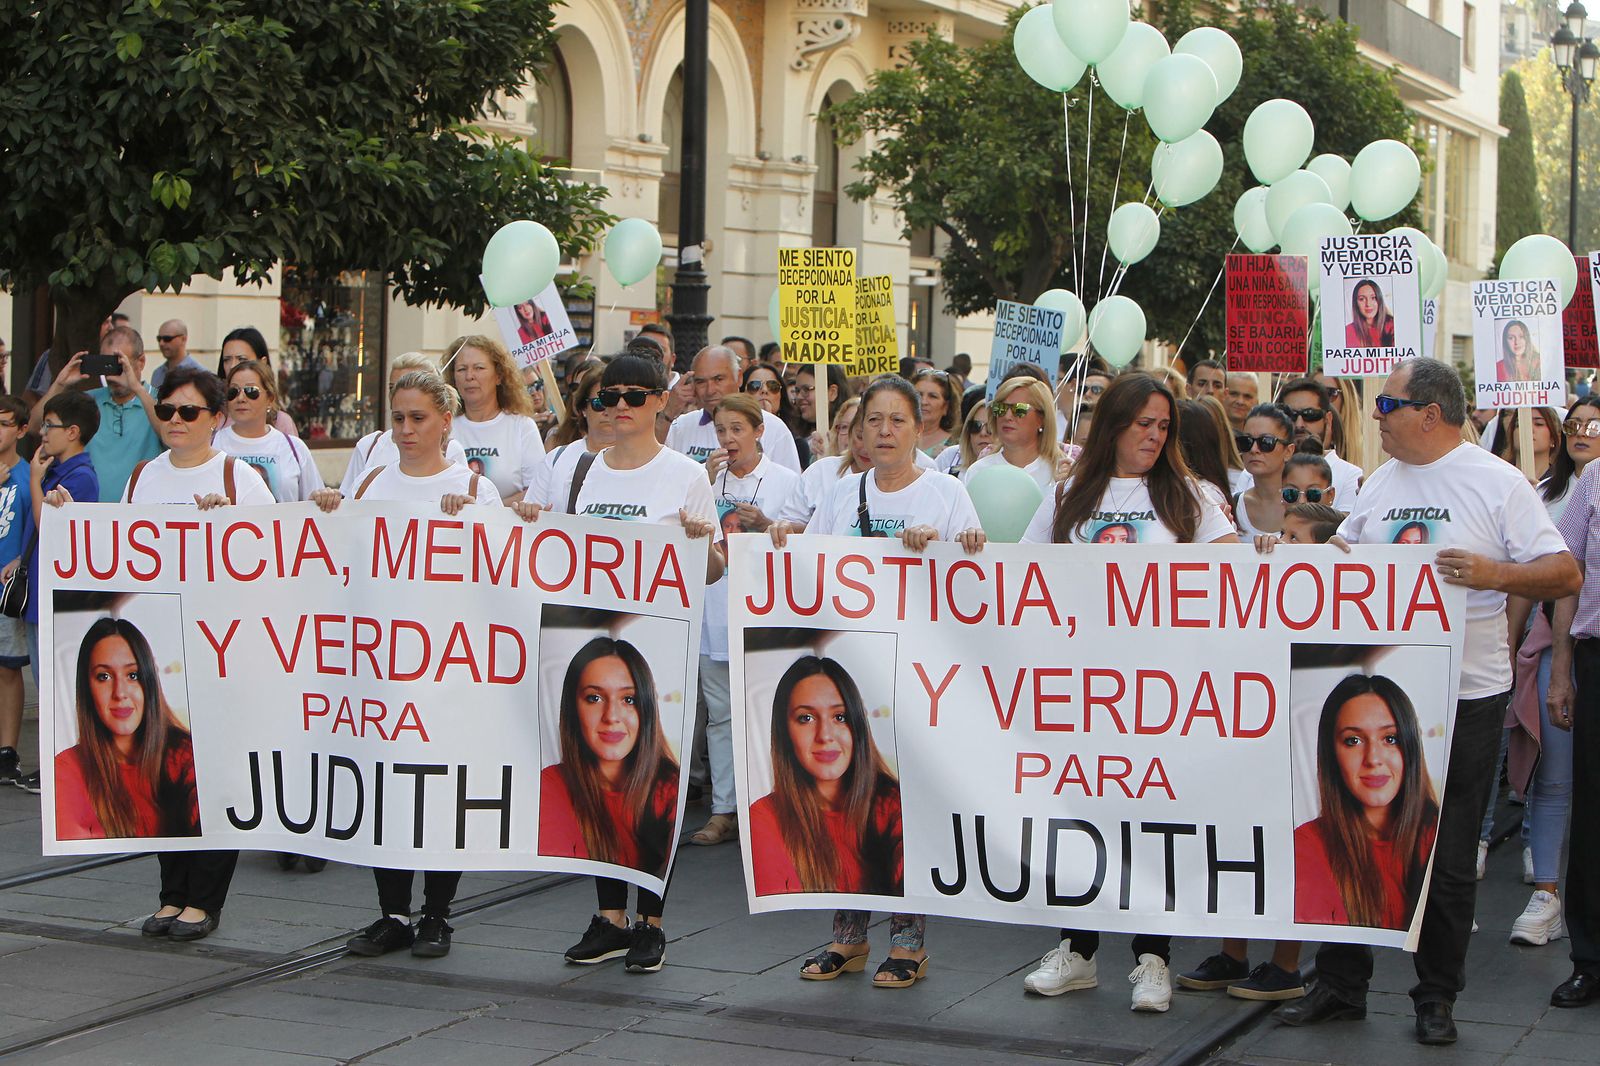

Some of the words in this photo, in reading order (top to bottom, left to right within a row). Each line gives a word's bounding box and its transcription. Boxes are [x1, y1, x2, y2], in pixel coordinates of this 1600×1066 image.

[1321, 235, 1412, 250] JUSTICIA
[779, 250, 799, 267] ME
[803, 250, 853, 267] SIENTO
[1322, 249, 1412, 263] MEMORIA
[1229, 256, 1243, 272] MI
[1247, 256, 1275, 272] HIJA
[1279, 256, 1306, 272] ERA
[1323, 263, 1334, 276] Y
[1339, 261, 1413, 276] VERDAD
[780, 269, 852, 286] DECEPCIONADA
[1229, 276, 1250, 291] UNA
[1252, 273, 1276, 291] NIÑA
[1278, 276, 1305, 291] SANA
[1474, 281, 1556, 295] JUSTICIA
[796, 290, 818, 304] POR
[822, 290, 836, 304] LA
[856, 292, 892, 310] PCIONADA
[1229, 294, 1235, 309] Y
[1236, 294, 1251, 309] MUY
[1254, 294, 1306, 310] RESPONSABLE
[1474, 292, 1557, 306] MEMORIA
[781, 307, 853, 329] JUSTICIA:
[856, 312, 867, 326] OR
[869, 311, 880, 324] LA
[997, 302, 1016, 321] ME
[1018, 306, 1063, 330] SIENTO
[1237, 311, 1297, 324] NUNCA
[1476, 306, 1486, 318] Y
[1490, 304, 1557, 317] VERDAD
[791, 330, 839, 341] COMO
[856, 325, 895, 346] STICIA:
[995, 321, 1059, 348] DECEPCIONADA
[1230, 326, 1245, 339] SE
[1250, 326, 1304, 339] BAJARIA
[512, 343, 535, 358] PARA
[536, 337, 547, 346] MI
[548, 328, 570, 342] HIJA
[858, 345, 886, 356] OMO
[1229, 341, 1245, 354] DE
[1247, 341, 1262, 354] UN
[1266, 342, 1305, 354] COCHE
[1580, 339, 1595, 351] UN
[525, 339, 566, 364] JUDITH
[783, 342, 853, 362] MADRE
[1006, 344, 1026, 360] POR
[1029, 348, 1041, 364] LA
[1326, 348, 1362, 358] PARA
[1366, 348, 1380, 358] MI
[1385, 347, 1415, 357] HIJA
[1230, 356, 1243, 369] EN
[1244, 356, 1305, 370] MARCHA
[1478, 383, 1511, 392] PARA
[1515, 382, 1528, 391] MI
[1532, 381, 1560, 390] HIJA
[1492, 391, 1548, 406] JUDITH
[464, 447, 499, 457] STICIA
[686, 445, 715, 457] JUST
[237, 455, 276, 464] STICIA
[580, 503, 648, 518] JUSTICIA
[1381, 507, 1451, 522] JUSTICIA
[850, 519, 905, 529] JSTICIA
[54, 519, 351, 587] JUSTICIA,
[372, 517, 689, 608] MEMORIA
[745, 551, 1077, 639] JUSTICIA,
[1106, 562, 1450, 633] MEMORIA
[197, 619, 241, 678] Y
[262, 614, 527, 685] VERDAD
[913, 662, 960, 728] Y
[981, 666, 1277, 738] VERDAD
[303, 693, 430, 743] PARA
[1014, 752, 1176, 801] PARA
[226, 751, 511, 849] JUDITH
[930, 812, 1265, 916] JUDITH
